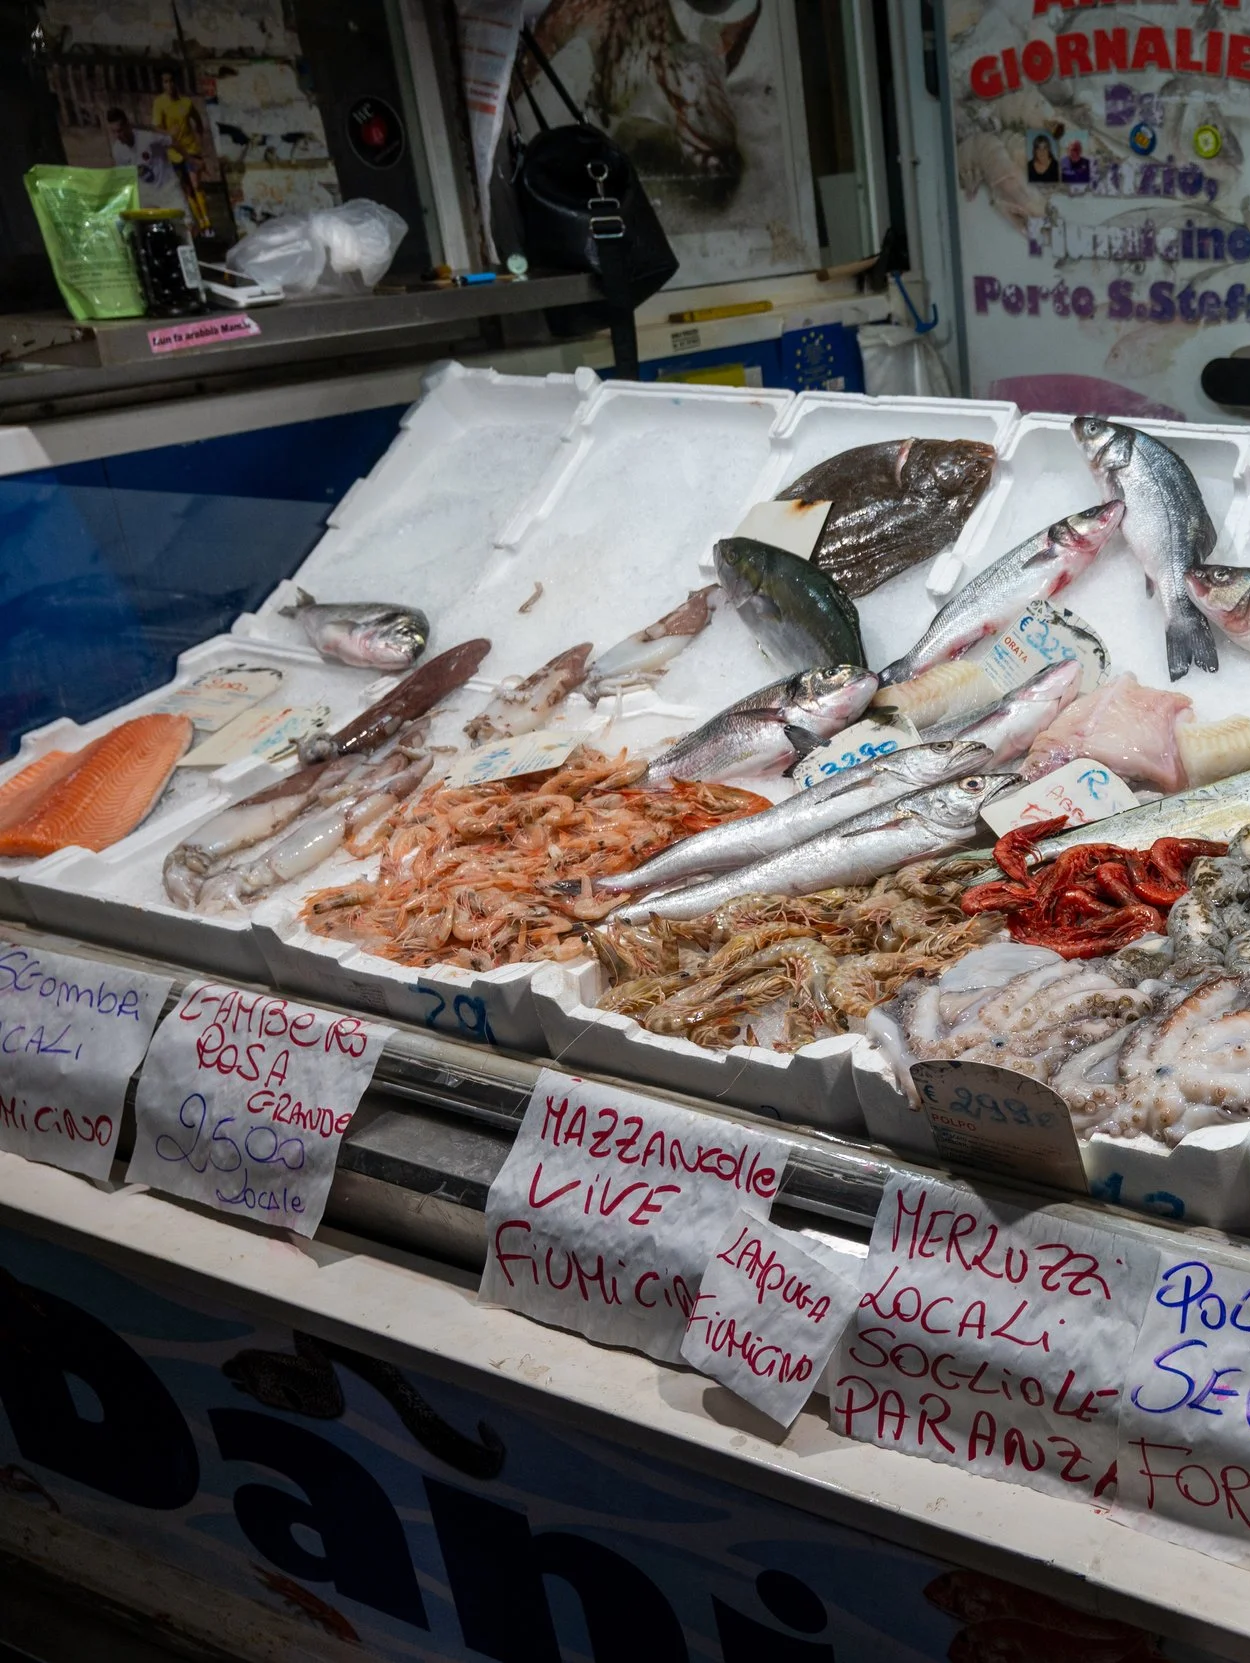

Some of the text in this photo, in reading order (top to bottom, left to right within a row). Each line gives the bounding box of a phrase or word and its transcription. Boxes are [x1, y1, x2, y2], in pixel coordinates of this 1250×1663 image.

[973, 275, 1096, 319] Porto
[1004, 636, 1028, 664] ORATA
[0, 1021, 94, 1060] CALi
[197, 1022, 289, 1087] ROSA
[931, 1112, 977, 1134] POLPO
[495, 1220, 696, 1318] FiUMiCiN
[835, 1375, 1119, 1498] PARANZA
